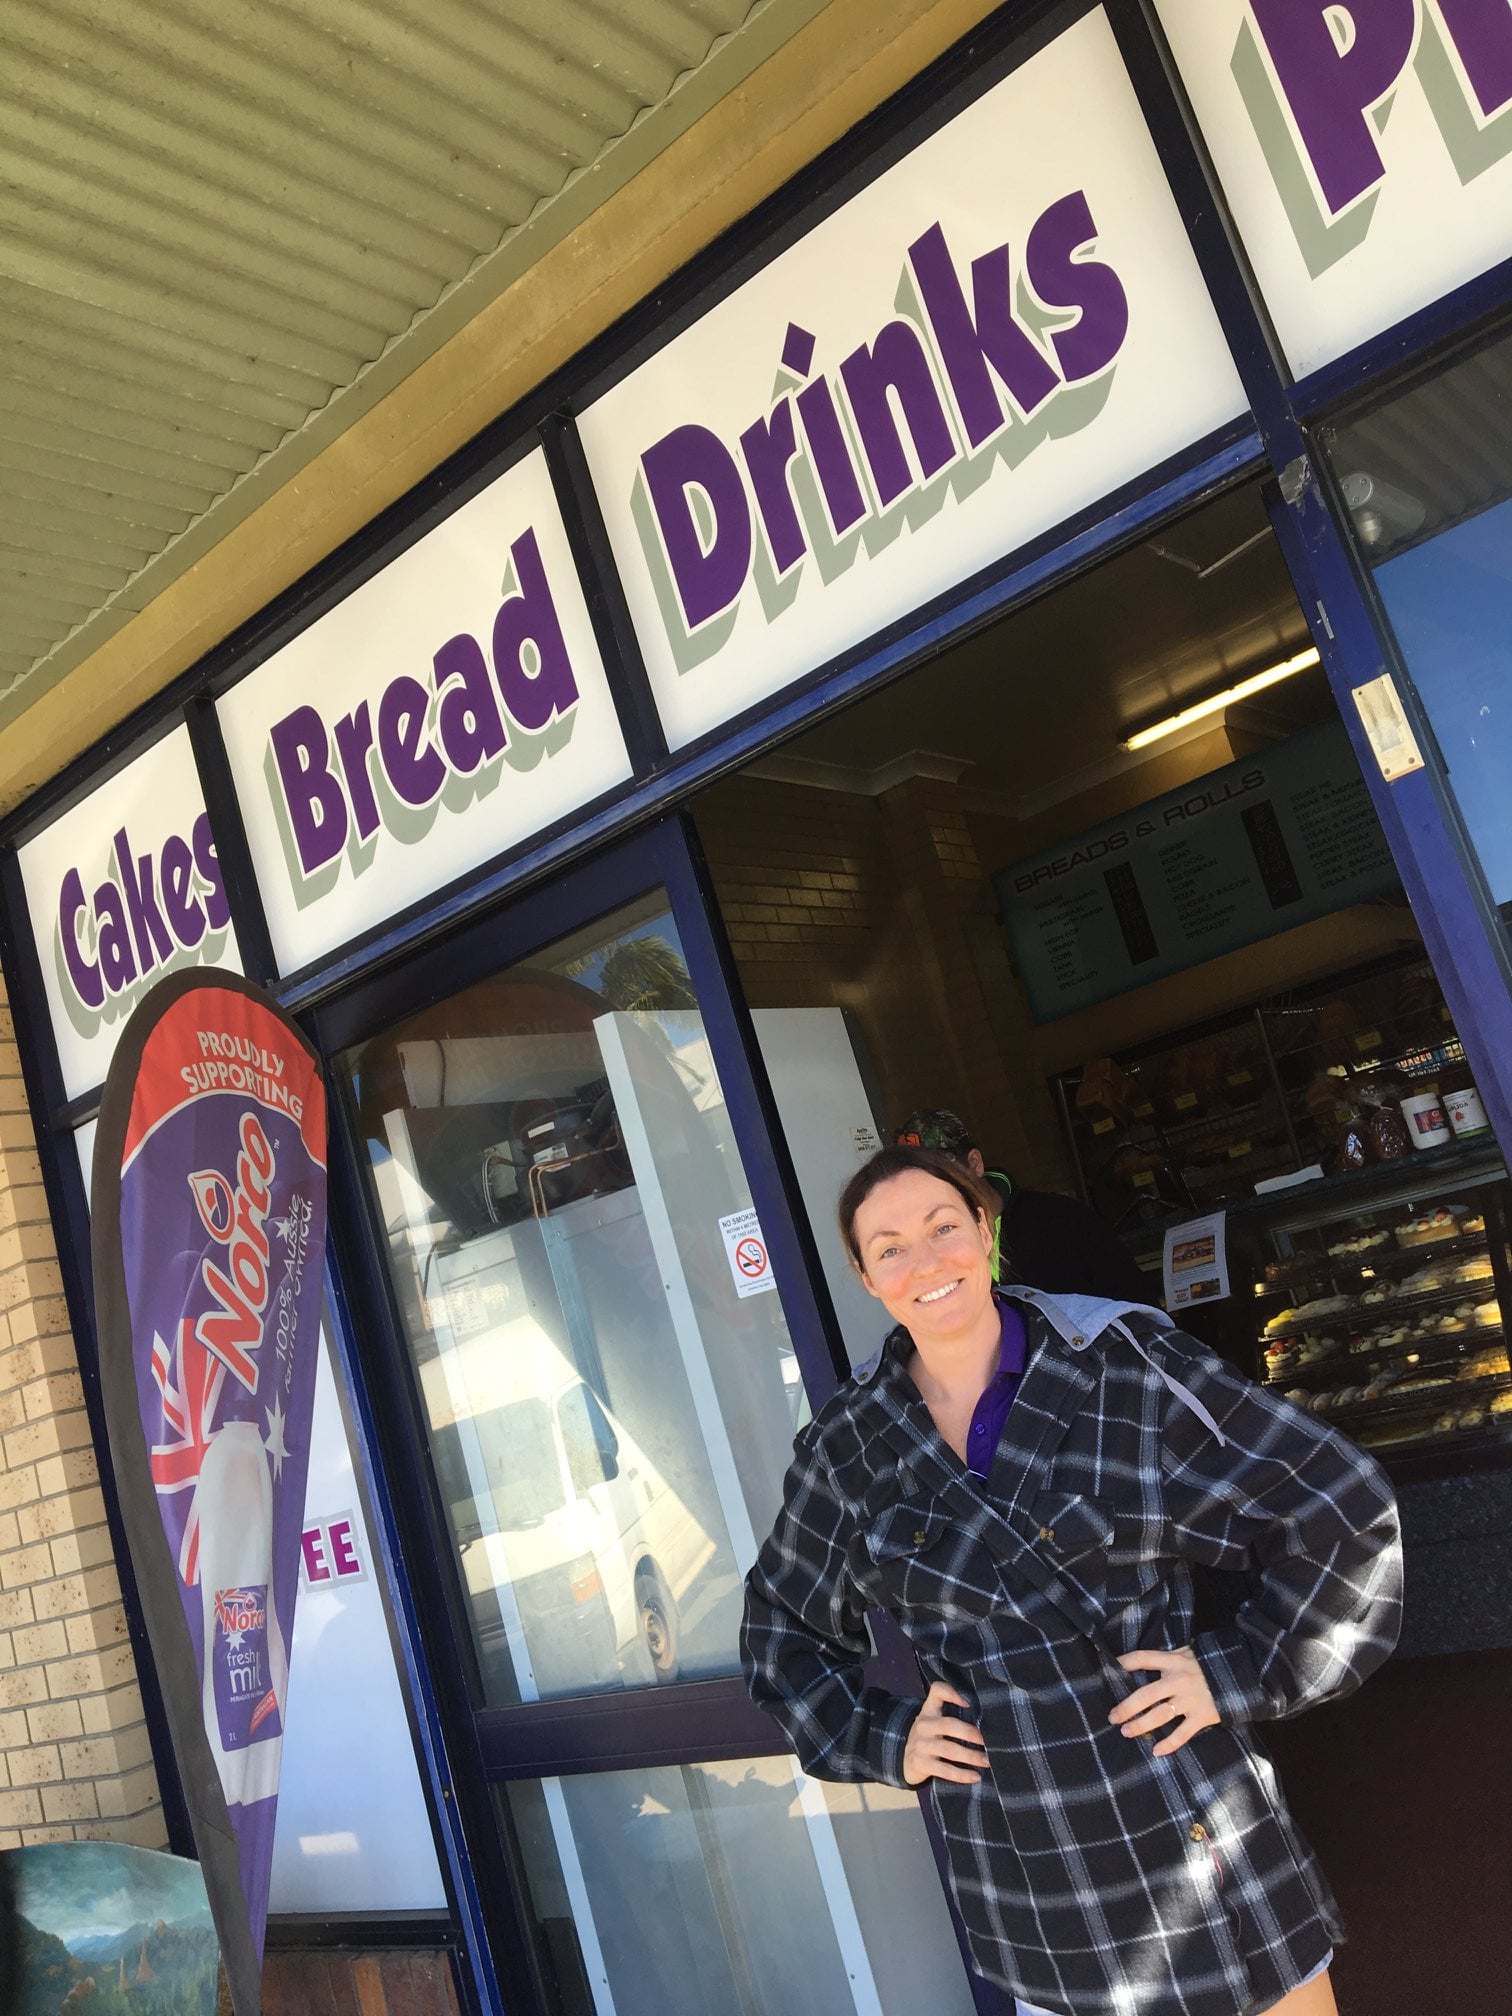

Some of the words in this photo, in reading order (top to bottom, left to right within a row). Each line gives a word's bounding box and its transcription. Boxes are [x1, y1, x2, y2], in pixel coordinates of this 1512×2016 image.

[641, 190, 1128, 629] Drinks
[270, 526, 579, 874] Bread
[1013, 832, 1130, 894] BREADS
[1135, 820, 1157, 838] &
[1163, 769, 1266, 827] ROLLS
[181, 1063, 302, 1118] SUPPORTING
[197, 1031, 284, 1077] PROUDLY
[196, 1112, 276, 1396] Norco
[276, 1286, 292, 1361] 100%
[284, 1193, 301, 1281] Aussie
[721, 1219, 731, 1227] NO
[731, 1210, 757, 1224] SMOKIN
[227, 1649, 256, 1667] fresh
